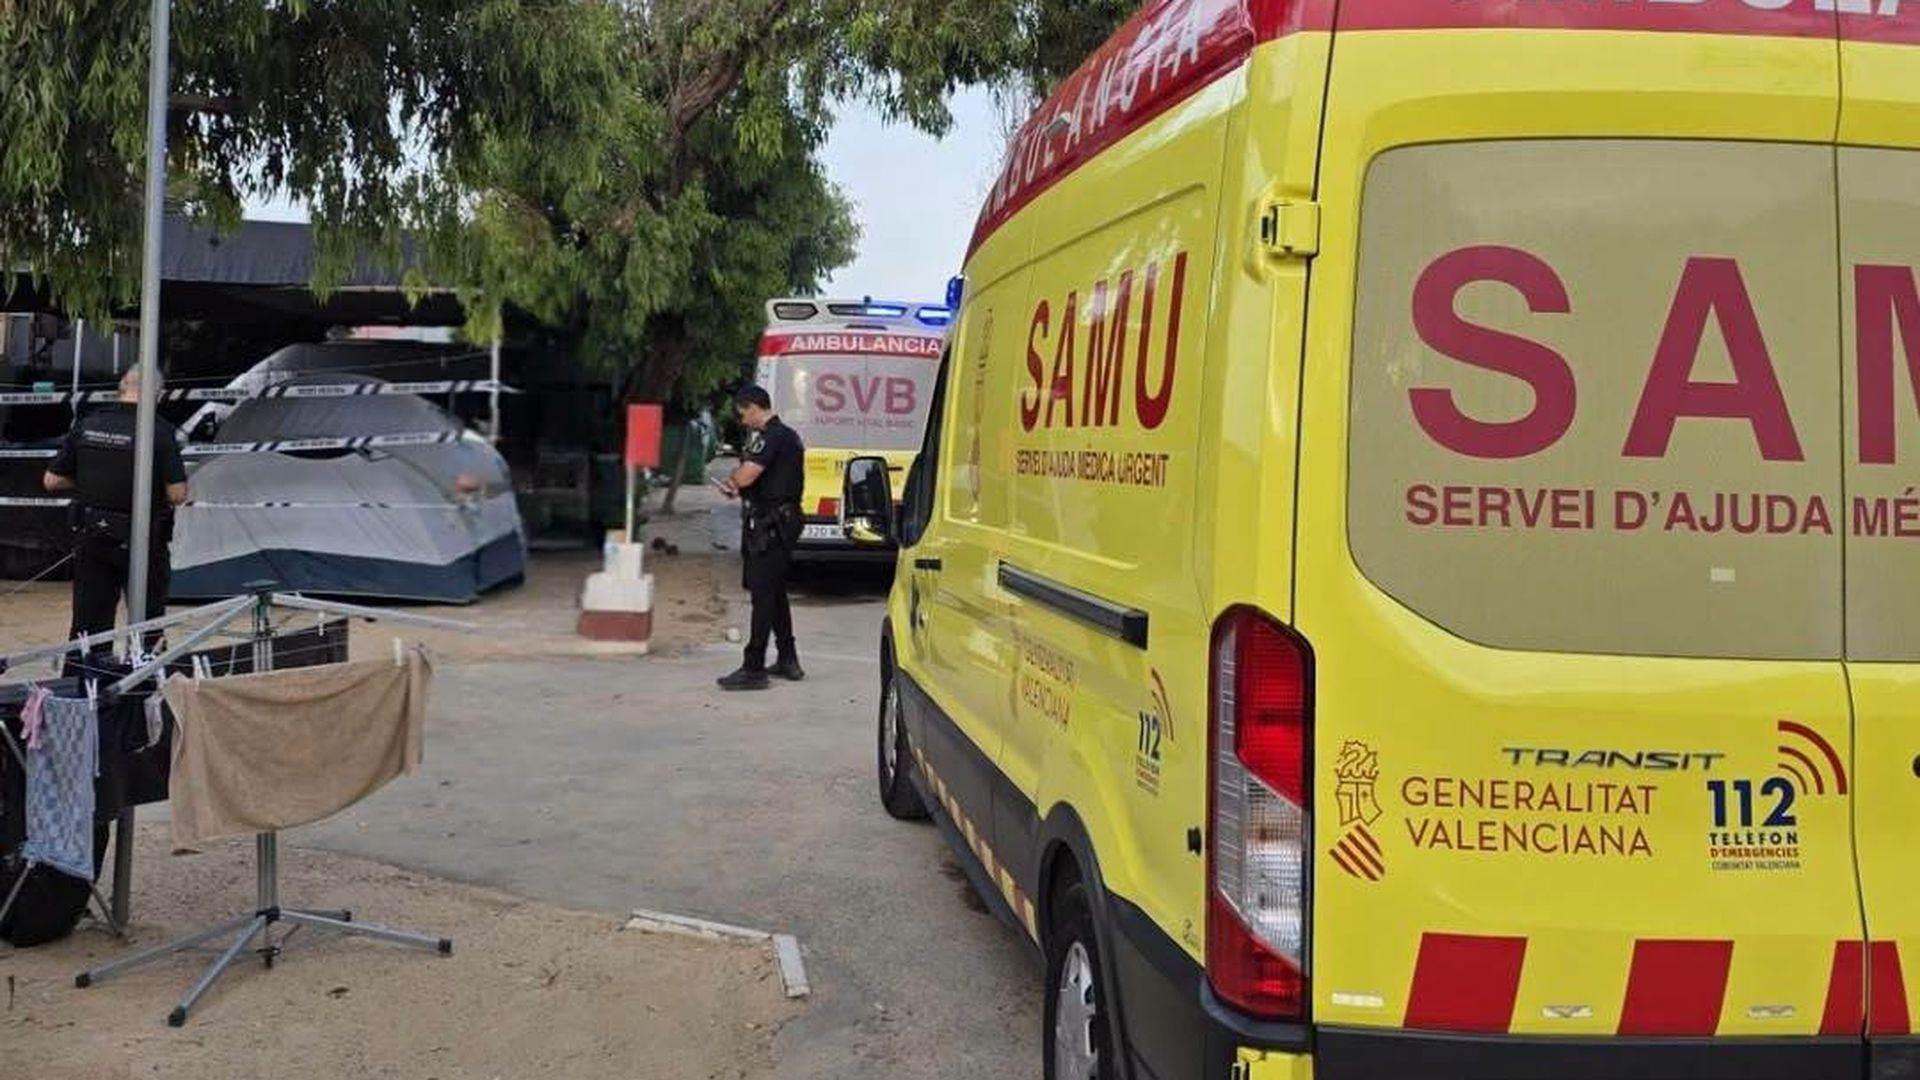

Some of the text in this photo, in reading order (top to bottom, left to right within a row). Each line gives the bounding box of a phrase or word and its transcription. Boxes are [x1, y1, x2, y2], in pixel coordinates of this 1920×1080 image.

[790, 335, 941, 353] AMBULANCIA
[1020, 251, 1187, 432] SAMU
[814, 373, 917, 415] SVB
[1117, 451, 1169, 488] URGENT
[1406, 485, 1920, 537] SERVEI D'AJUDA MÉ
[1139, 710, 1161, 761] 112
[1501, 746, 1726, 771] TRANSIT
[1401, 776, 1658, 815] GENERALITAT
[1706, 777, 1797, 828] 112
[1405, 817, 1653, 857] VALENCIANA
